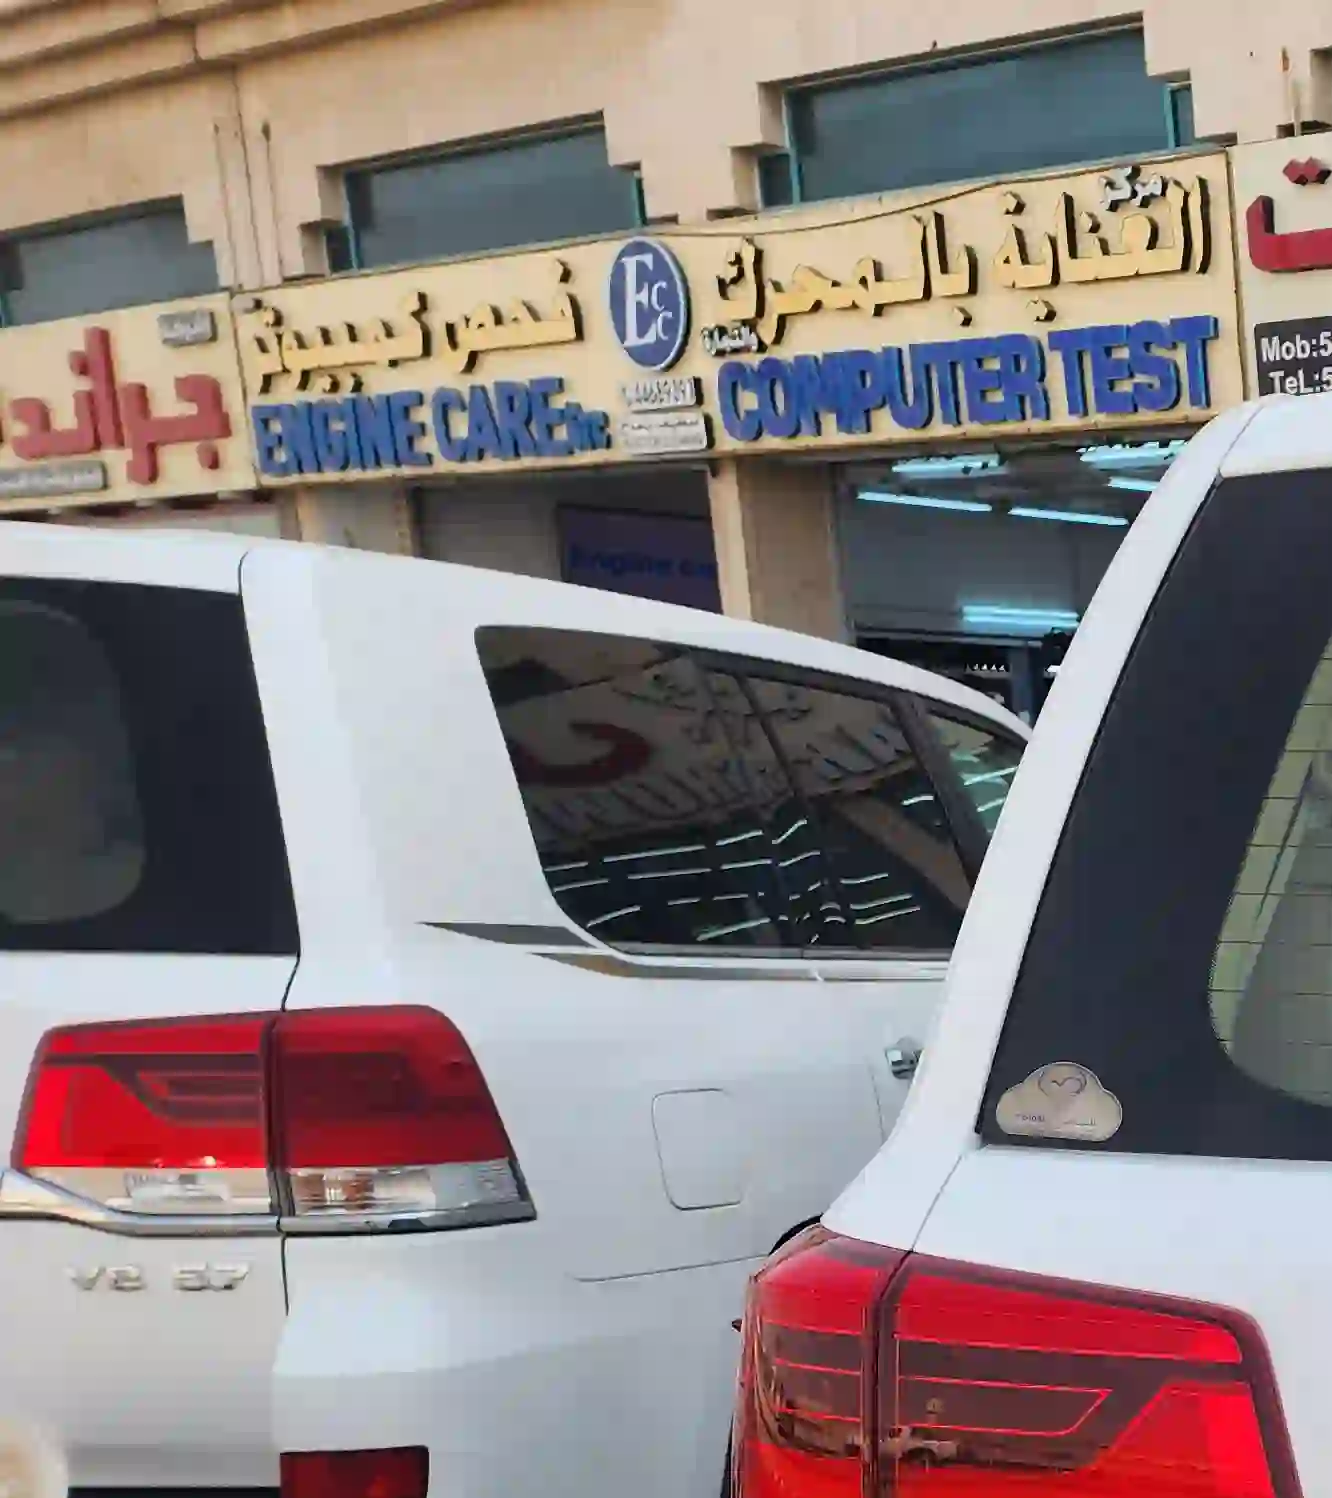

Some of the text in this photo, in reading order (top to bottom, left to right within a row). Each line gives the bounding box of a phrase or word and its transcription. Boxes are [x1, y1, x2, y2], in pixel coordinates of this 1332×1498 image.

[444, 258, 584, 375] فحص
[716, 174, 1212, 345] العناية بالمحرك
[252, 389, 433, 477] ENGINE
[432, 376, 570, 463] CARE
[717, 314, 1220, 442] COMPUTER TEST
[66, 1263, 147, 1292] V8
